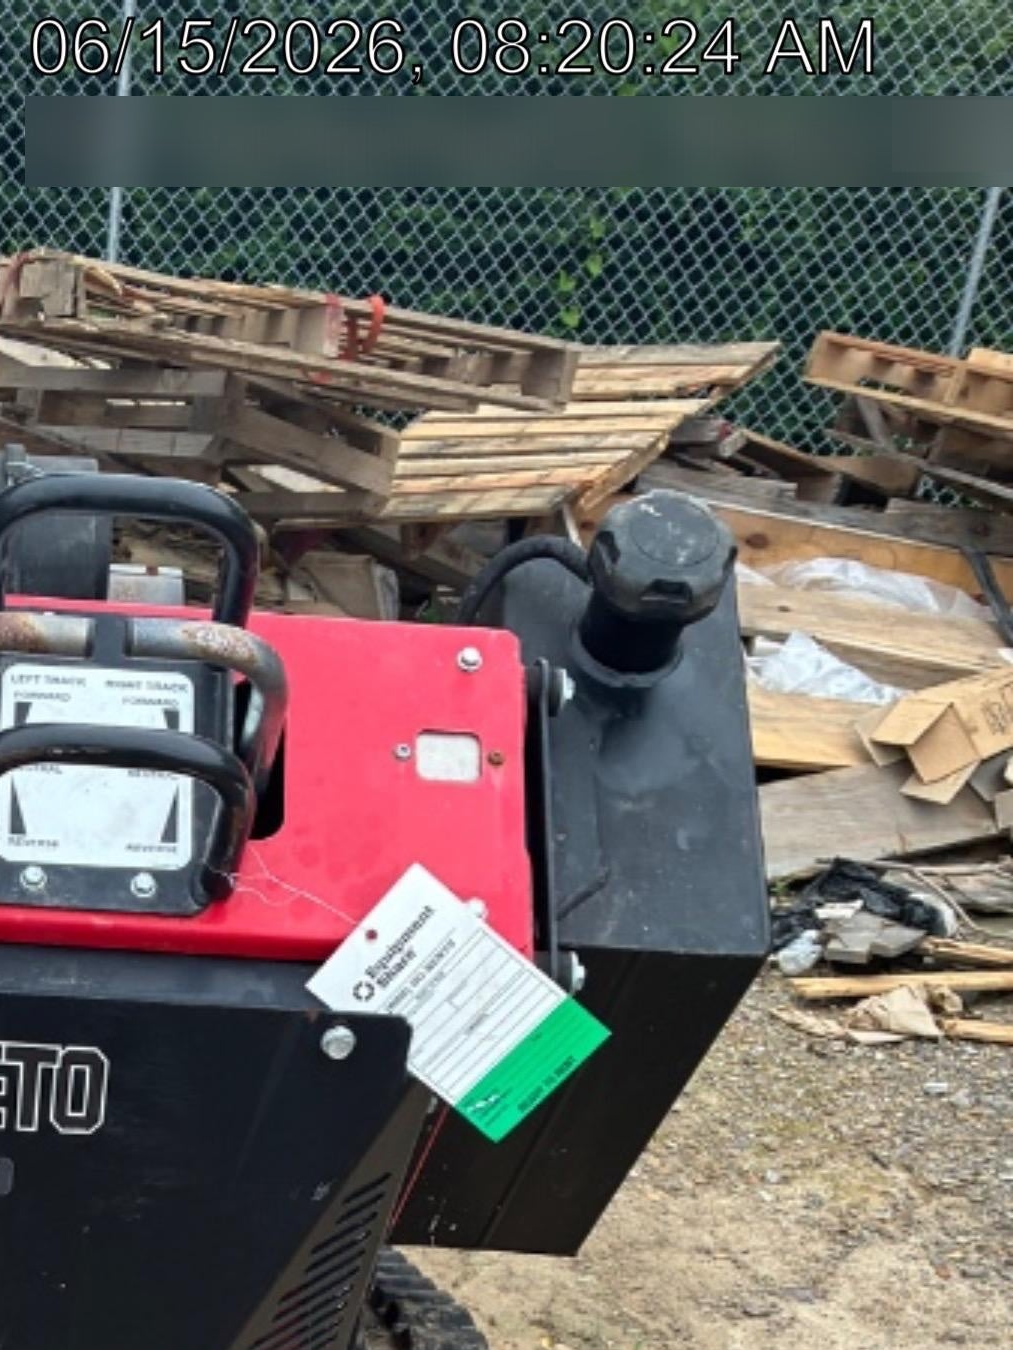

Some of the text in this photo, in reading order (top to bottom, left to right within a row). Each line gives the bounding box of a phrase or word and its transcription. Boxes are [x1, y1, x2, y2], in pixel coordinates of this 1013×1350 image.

[10, 673, 87, 688] LEFT TRACK
[146, 681, 189, 693] TRACK
[13, 691, 72, 702] FORWARD
[121, 696, 180, 707] FORWARD
[365, 905, 435, 979] Equipment
[376, 949, 416, 989] Share
